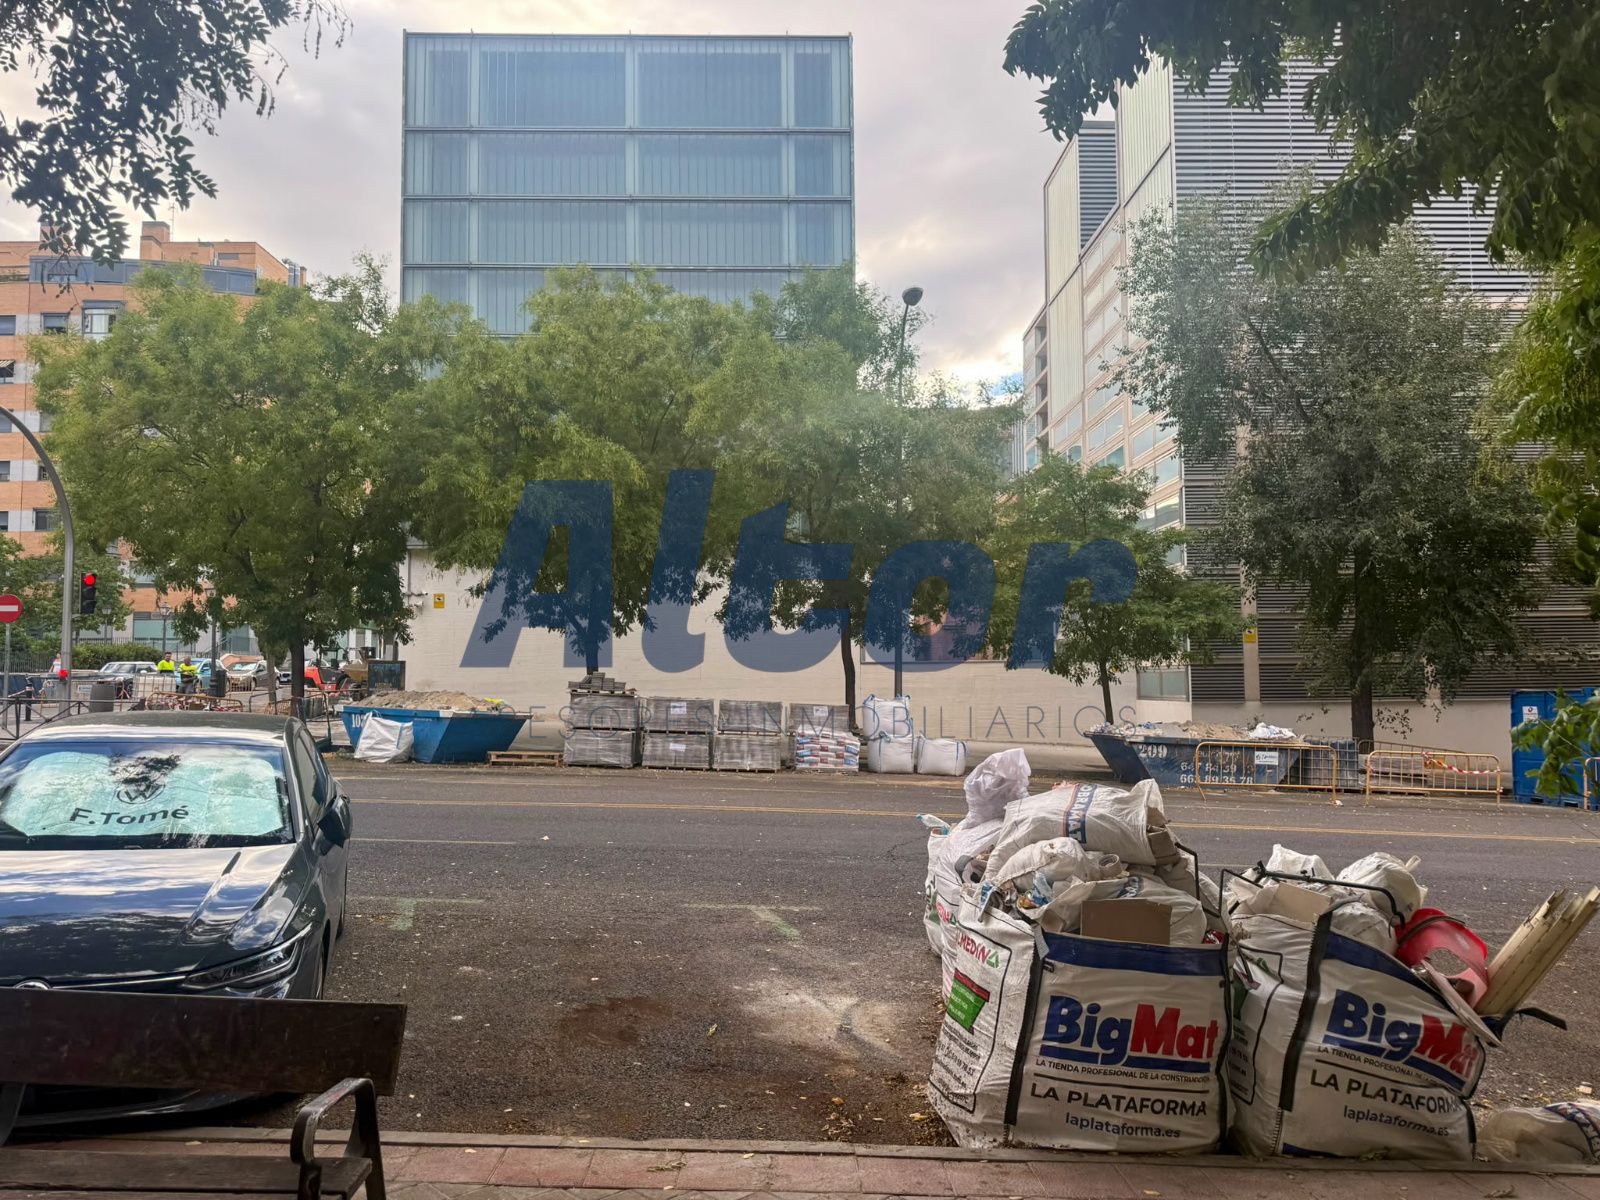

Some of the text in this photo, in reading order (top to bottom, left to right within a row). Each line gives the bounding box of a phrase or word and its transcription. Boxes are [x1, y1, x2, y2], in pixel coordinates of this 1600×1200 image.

[1138, 744, 1168, 759] 209
[1180, 773, 1199, 784] 66
[69, 804, 189, 825] F.Tomé
[1042, 995, 1219, 1066] BigMat
[1317, 1045, 1329, 1054] LA
[1332, 1048, 1362, 1063] TIENDA
[1035, 1058, 1047, 1068] LA
[1048, 1060, 1080, 1073] TIENDA
[1081, 1066, 1137, 1079] PROFESIONAL
[1139, 1071, 1149, 1079] DE
[1150, 1072, 1160, 1081] LA
[1310, 1069, 1340, 1092] LA
[1030, 1082, 1207, 1116] LA PLATAFORMA
[1065, 1112, 1181, 1138] laplataforma.es
